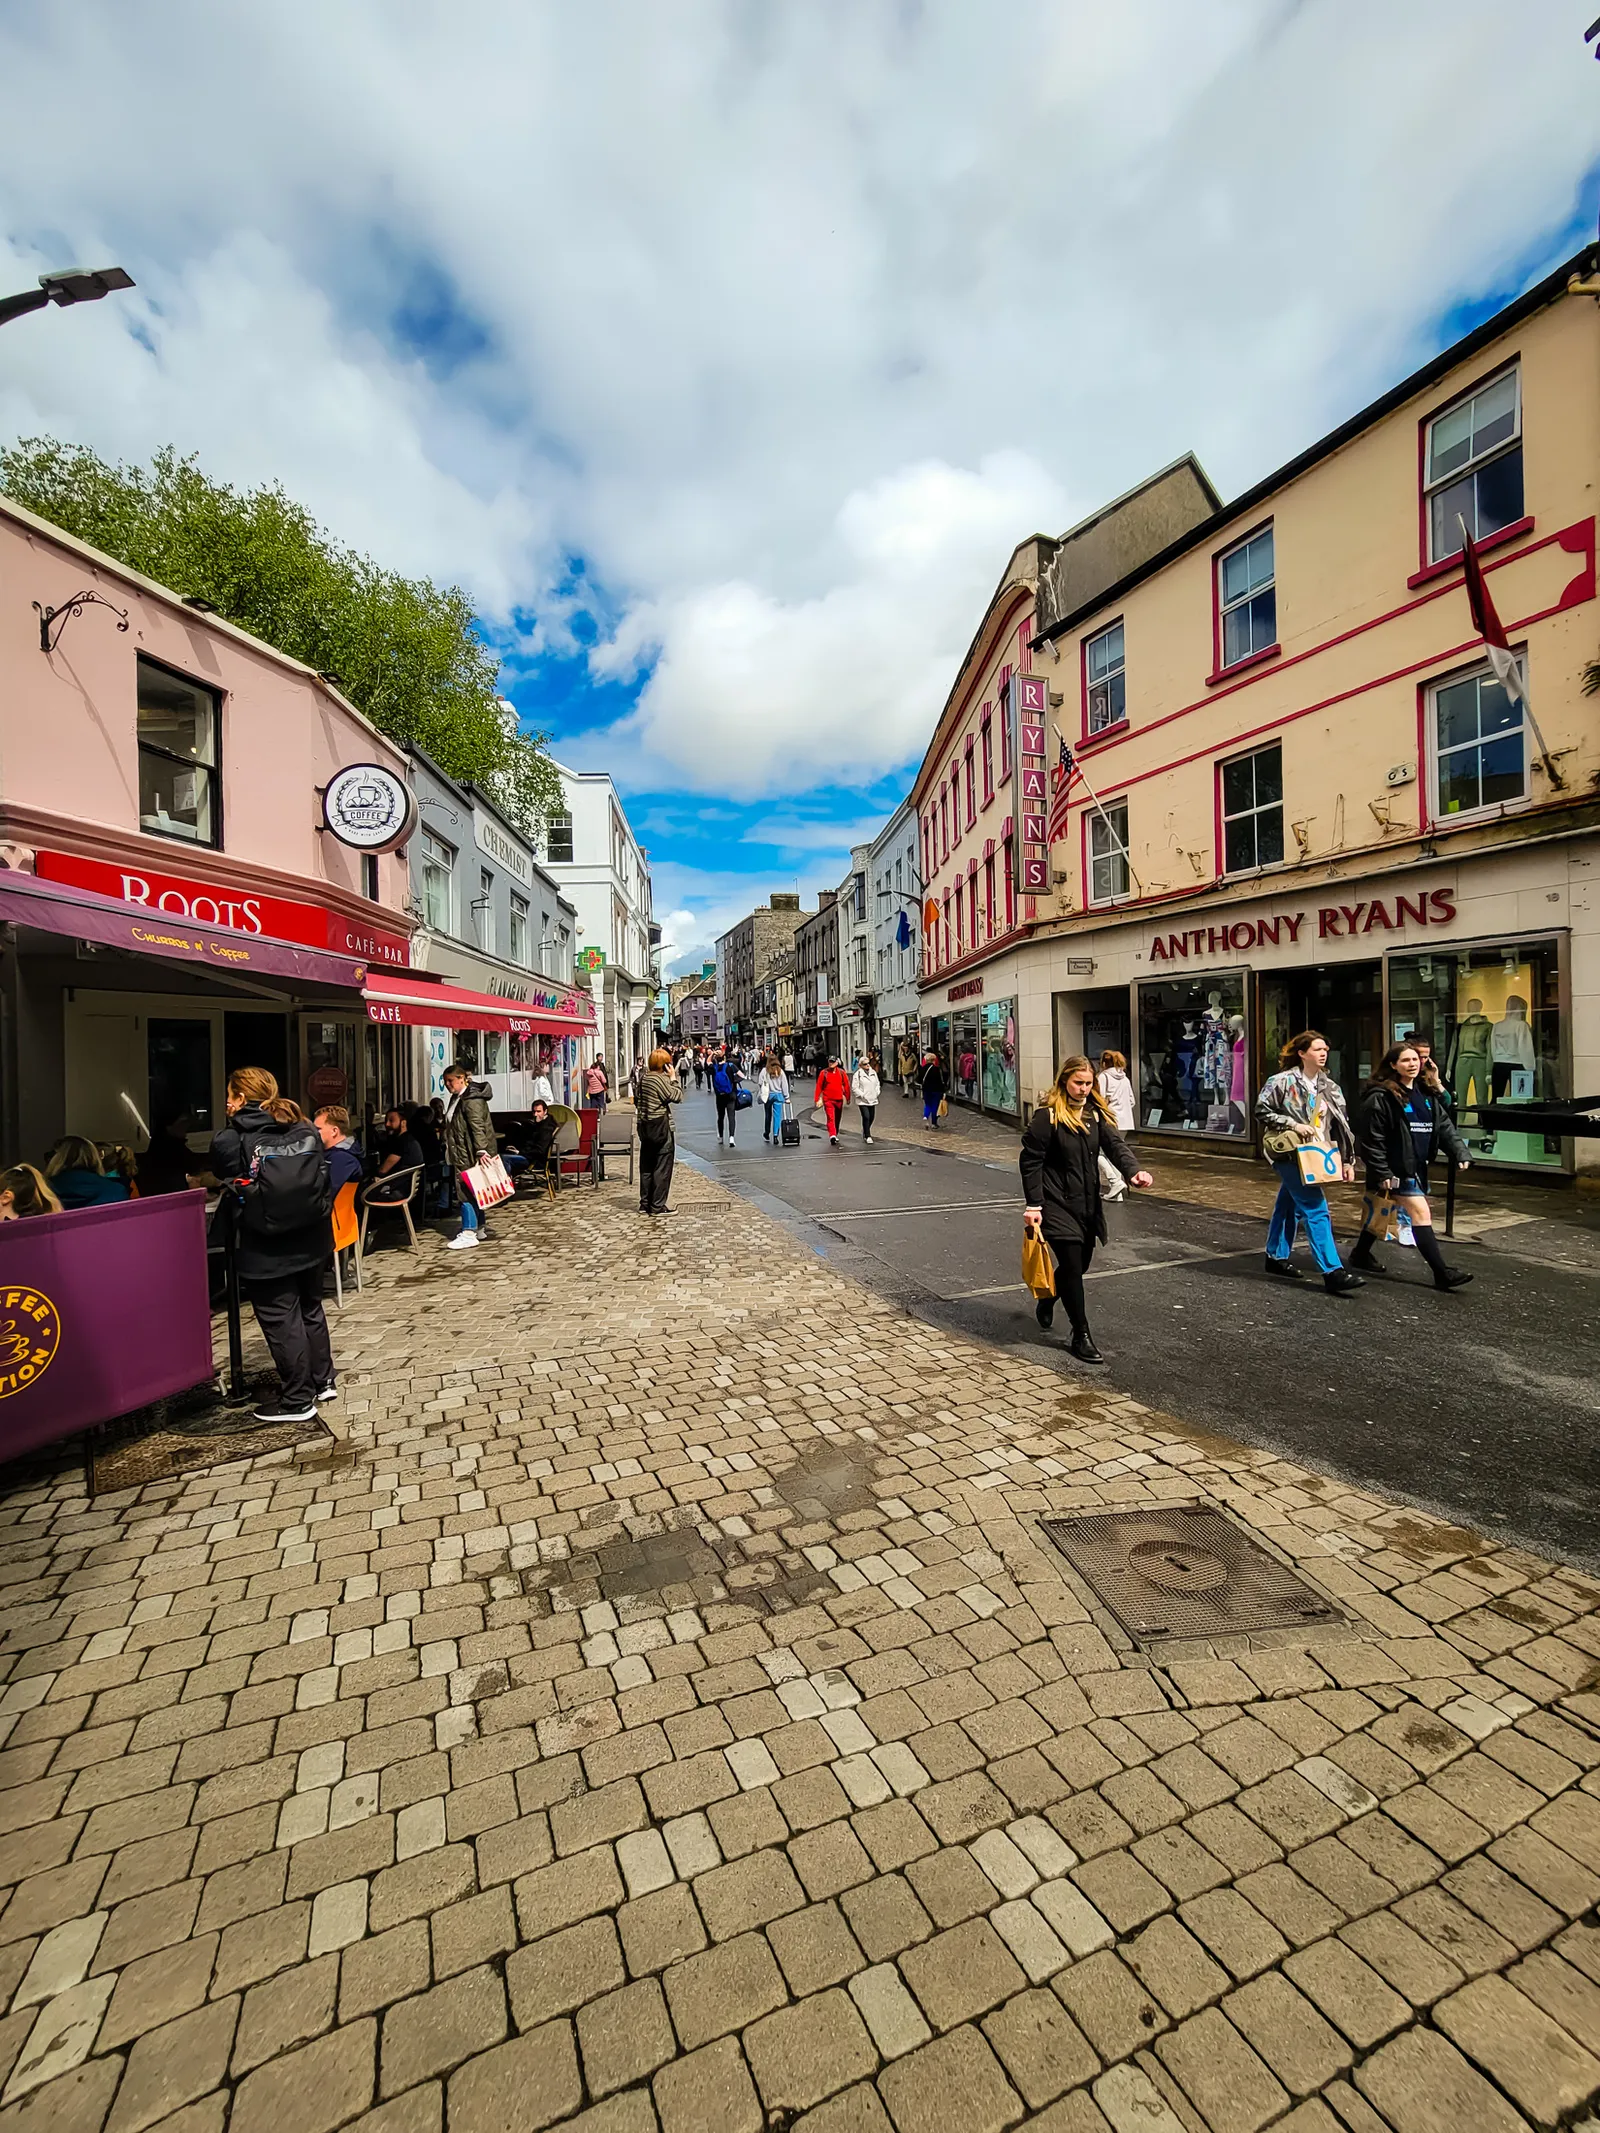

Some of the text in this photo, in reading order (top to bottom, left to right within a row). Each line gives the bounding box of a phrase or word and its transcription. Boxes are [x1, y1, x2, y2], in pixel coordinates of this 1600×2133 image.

[1025, 684, 1042, 884] RYANS
[350, 811, 381, 820] COFFEE
[483, 824, 527, 879] CHEMIST
[120, 874, 262, 935] ROOTS
[1545, 892, 1560, 903] 18
[1149, 888, 1457, 962] ANTHONY RYANS
[346, 933, 403, 964] CAFÉ BAR
[370, 1006, 401, 1022] CAFÉ
[0, 1292, 50, 1322] FEE
